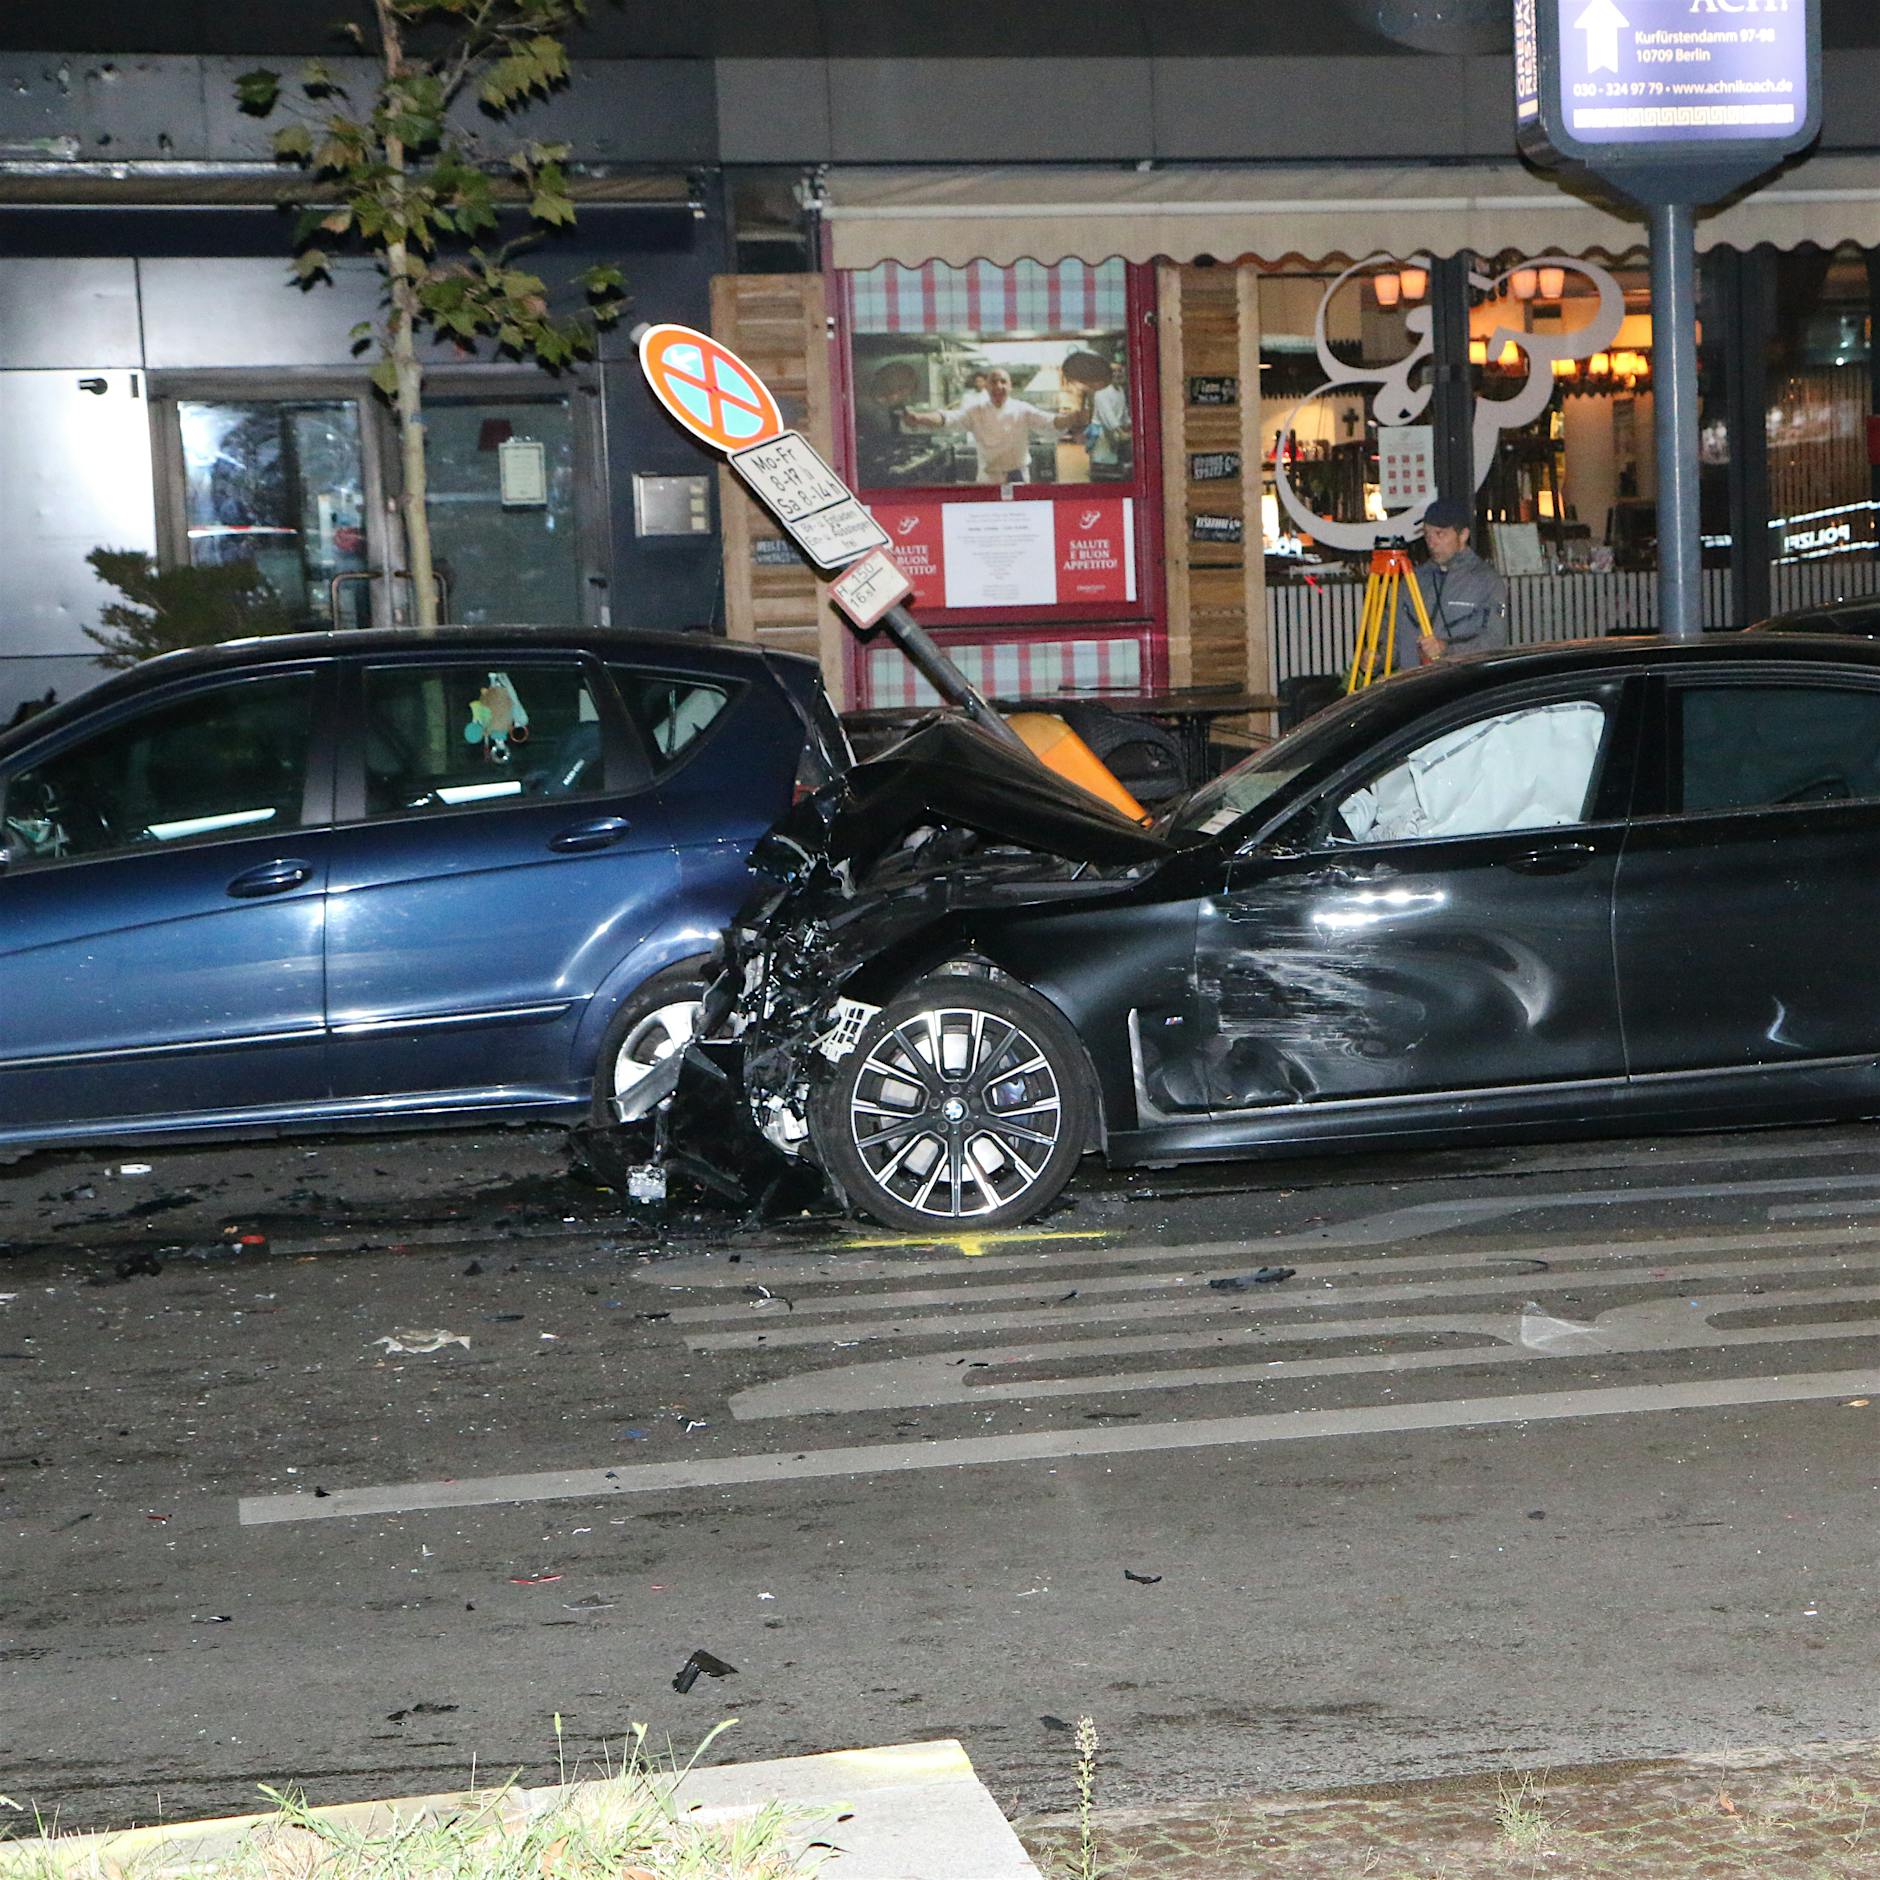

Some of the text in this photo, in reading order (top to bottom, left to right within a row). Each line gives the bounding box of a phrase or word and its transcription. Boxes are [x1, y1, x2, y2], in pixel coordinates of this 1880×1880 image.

[1635, 29, 1738, 45] Kurfürstendamm
[1636, 48, 1711, 63] 10709 Berlin
[1573, 83, 1596, 97] 030
[1606, 82, 1629, 96] 324
[1630, 82, 1646, 95] 97
[1647, 81, 1664, 95] 79
[777, 498, 801, 515] Sa
[797, 482, 832, 506] 8-14
[895, 545, 928, 554] ALUTE
[1070, 539, 1109, 549] SALUTE
[1071, 549, 1110, 560] E BUON
[1063, 558, 1117, 570] APPETITO!
[852, 563, 874, 584] 150
